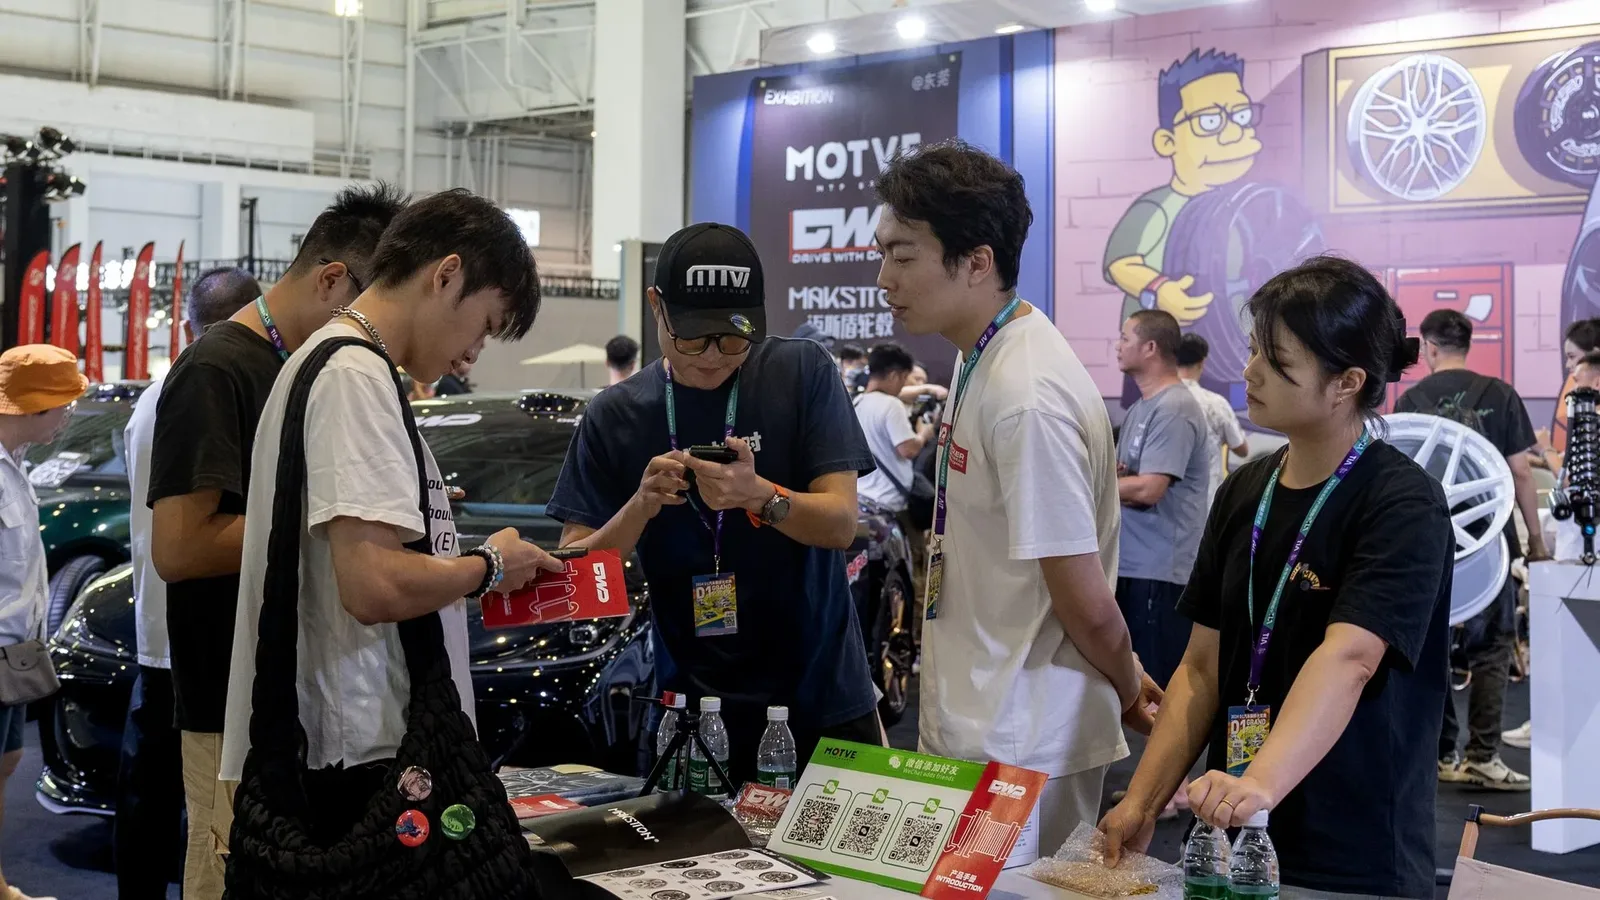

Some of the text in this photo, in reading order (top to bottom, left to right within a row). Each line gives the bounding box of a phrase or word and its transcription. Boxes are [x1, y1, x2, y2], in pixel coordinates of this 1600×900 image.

[763, 89, 833, 106] EXHIBITION
[792, 253, 831, 264] DRIVE
[833, 251, 864, 262] WITH
[823, 746, 857, 759] MOTVE
[905, 757, 960, 776] 微信添加好友
[935, 874, 983, 892] INTRODUCTION
[949, 869, 978, 883] 产品手册
